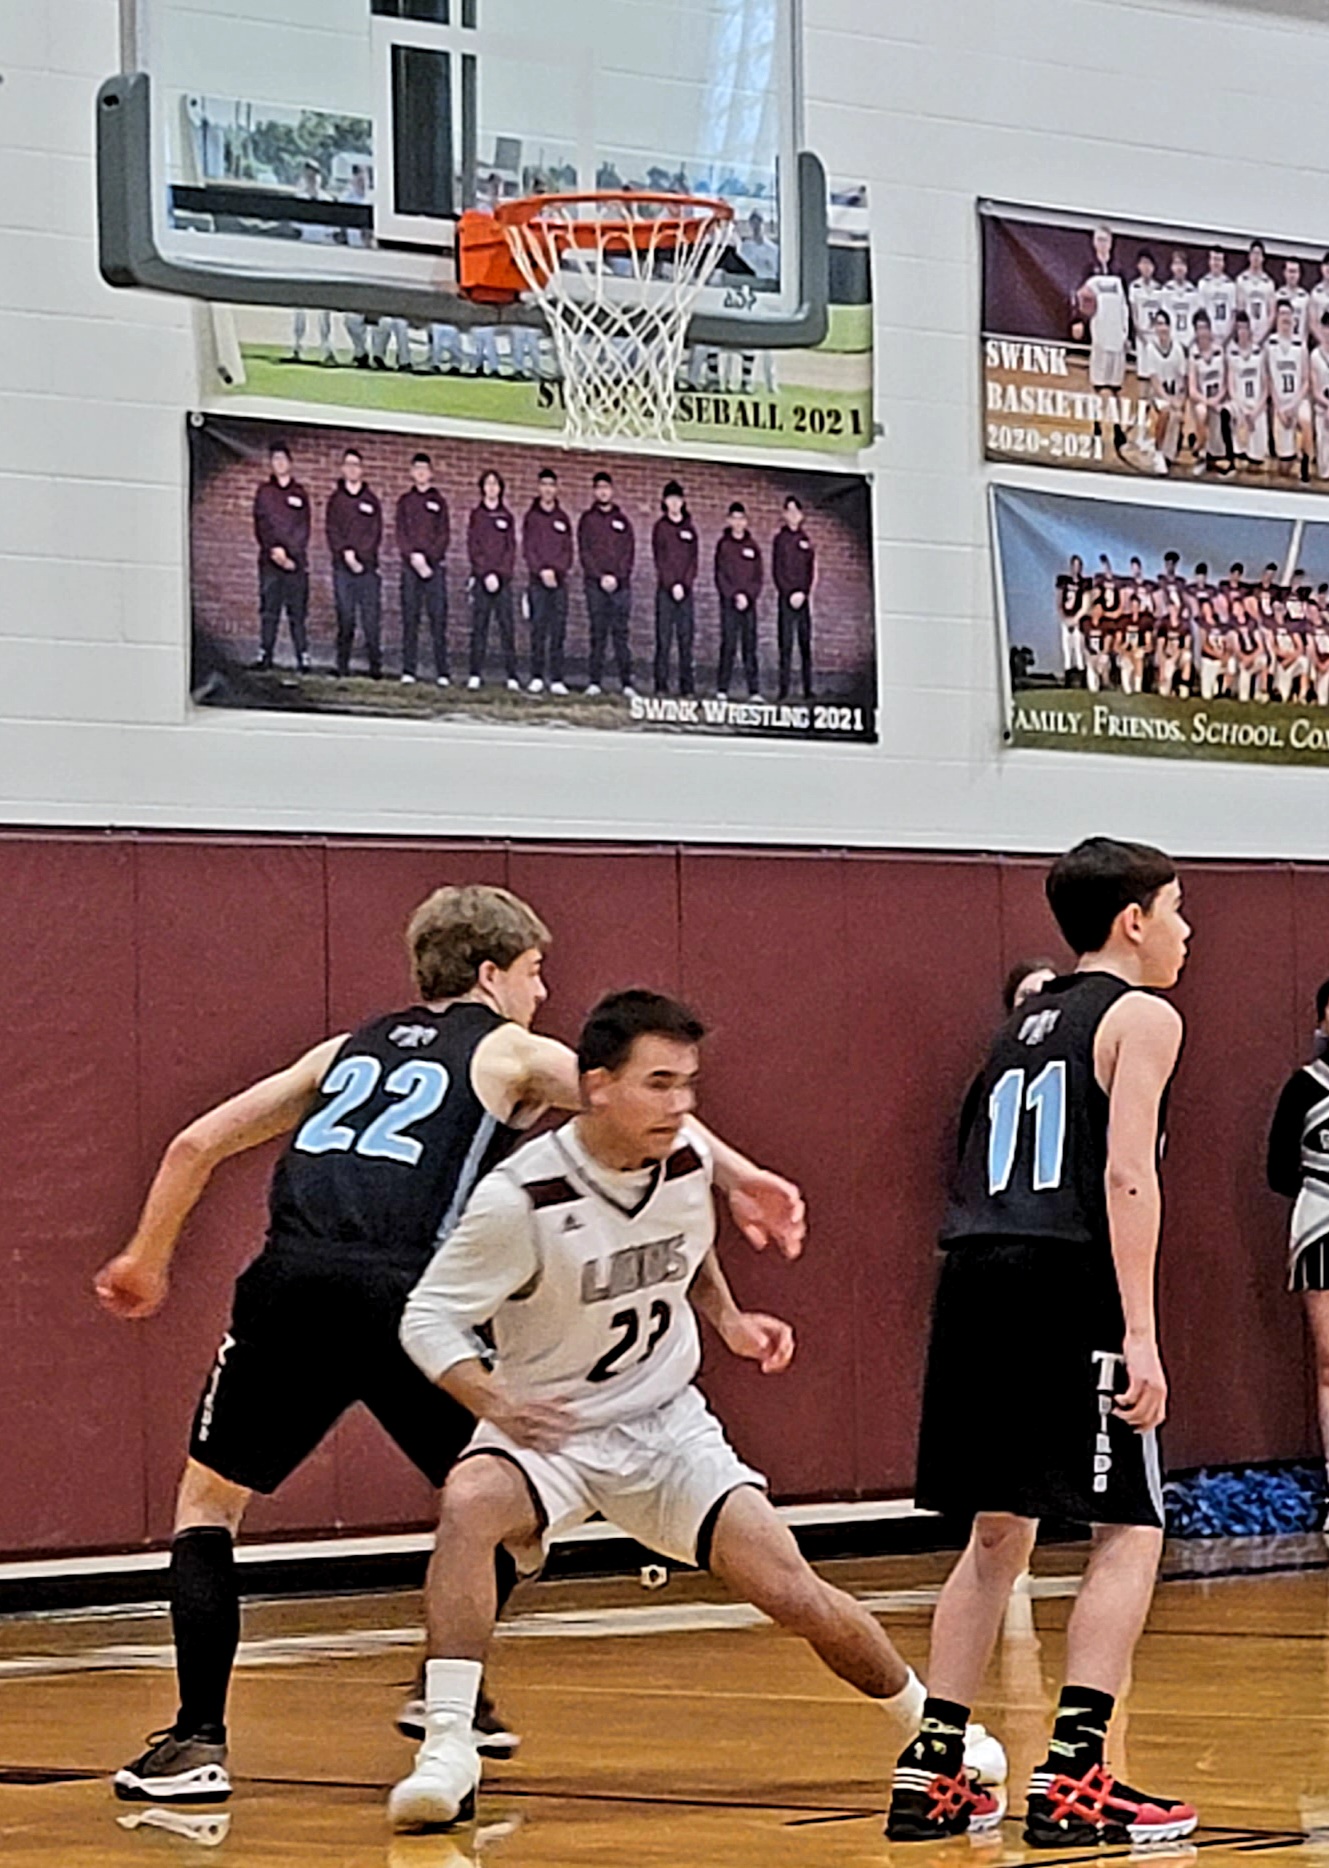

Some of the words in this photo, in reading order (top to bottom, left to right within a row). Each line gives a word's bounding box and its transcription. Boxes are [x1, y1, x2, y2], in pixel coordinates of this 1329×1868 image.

[986, 340, 1068, 376] SWINK
[640, 389, 783, 432] SEBALL
[793, 407, 863, 435] 2021
[987, 381, 1151, 428] BASKETBALL
[987, 424, 1103, 460] 2020-2021
[630, 699, 699, 723] SWINK
[702, 700, 810, 729] WRESTLING
[813, 706, 863, 731] 2021
[1014, 707, 1087, 736] AMILY.
[295, 1056, 449, 1165] 22
[989, 1060, 1066, 1196] 11
